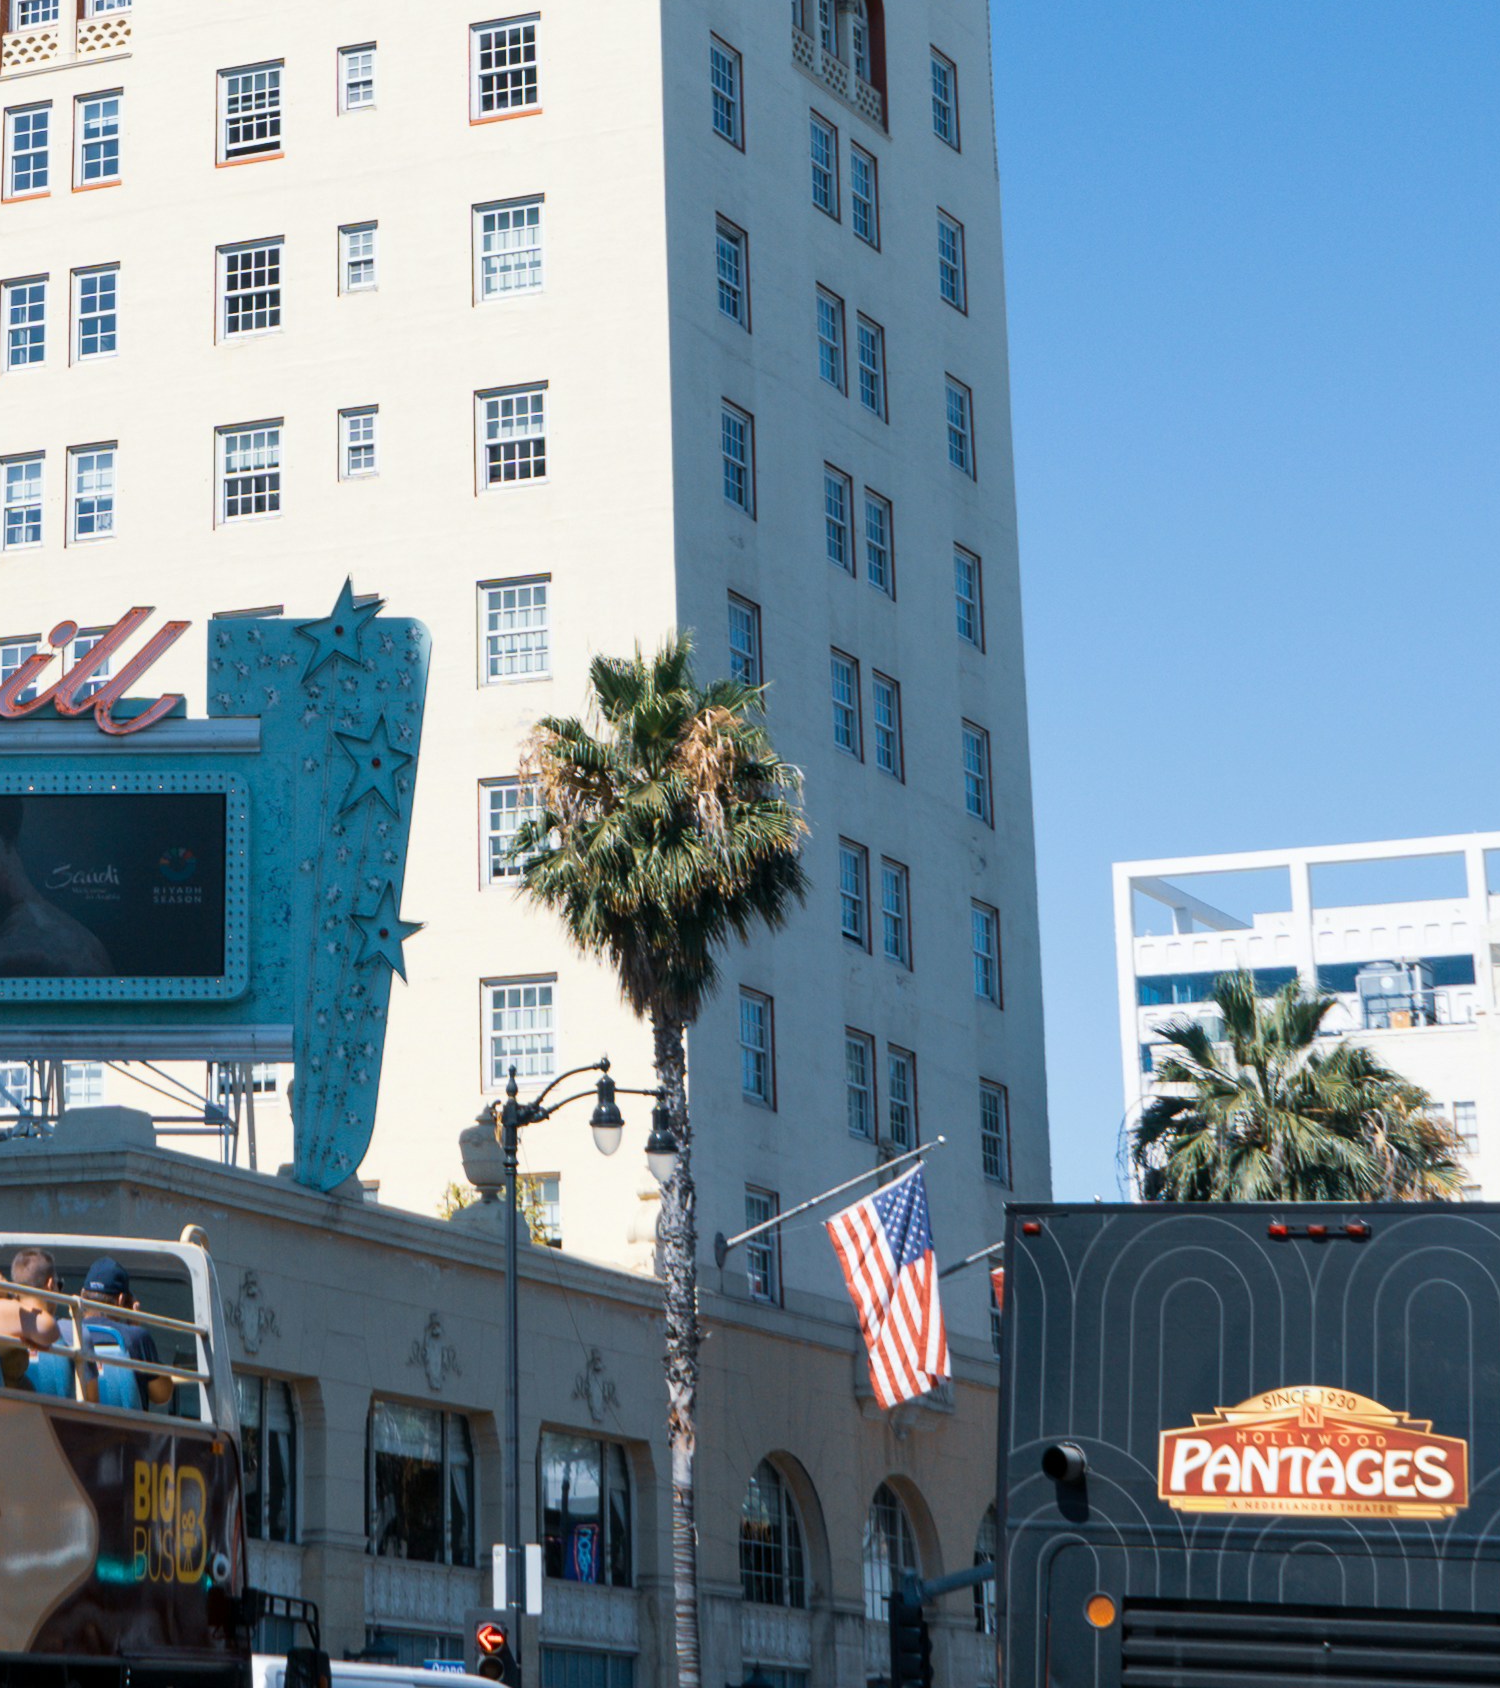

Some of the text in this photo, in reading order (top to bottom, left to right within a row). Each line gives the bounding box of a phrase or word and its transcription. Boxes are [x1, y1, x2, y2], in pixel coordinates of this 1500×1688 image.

[153, 886, 202, 894] RIYADH
[153, 895, 202, 904] SEASON
[1262, 1389, 1358, 1411] SINCE 1930
[1236, 1431, 1388, 1447] HOLLYWOOD
[1169, 1438, 1456, 1499] PANTAGES
[134, 1460, 175, 1523] BIG
[1245, 1501, 1334, 1512] NEDERLANDER
[1339, 1503, 1395, 1514] THEATRE
[134, 1526, 175, 1583] BUS
